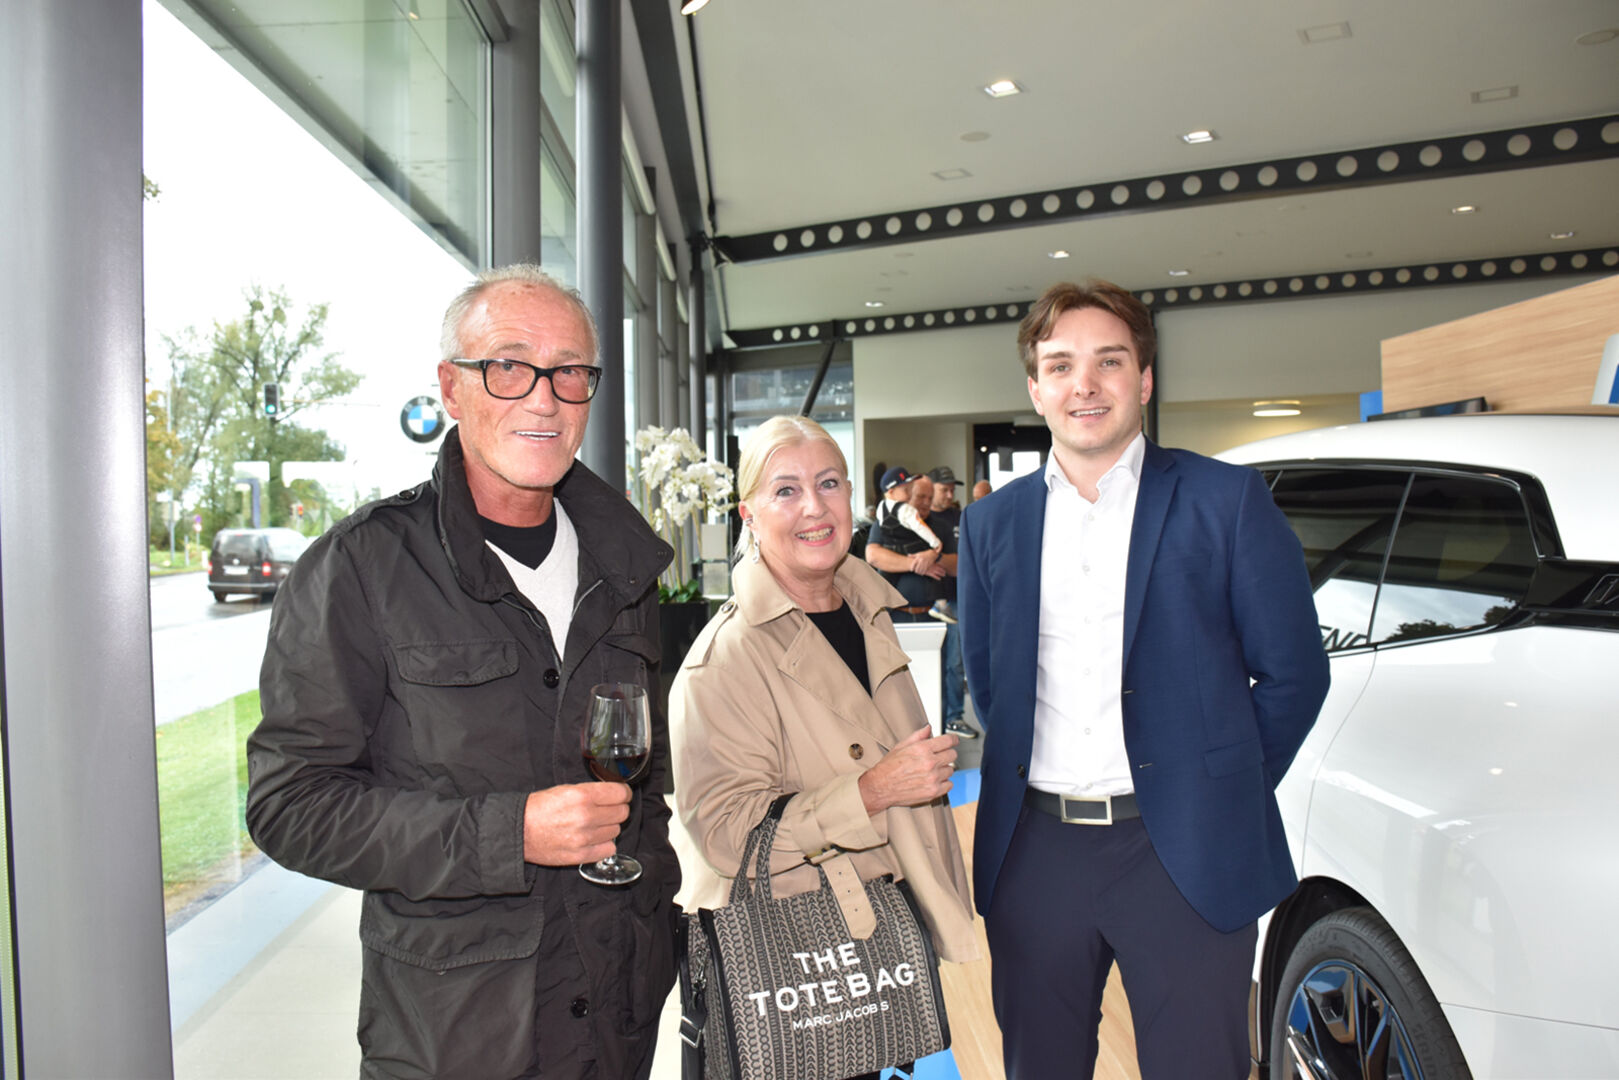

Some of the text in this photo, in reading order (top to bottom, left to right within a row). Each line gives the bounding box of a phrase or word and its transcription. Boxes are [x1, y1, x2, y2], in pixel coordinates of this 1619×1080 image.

[793, 942, 860, 974] THE
[749, 963, 914, 1016] TOTE BAG
[793, 1001, 889, 1030] MARC JACOBS
